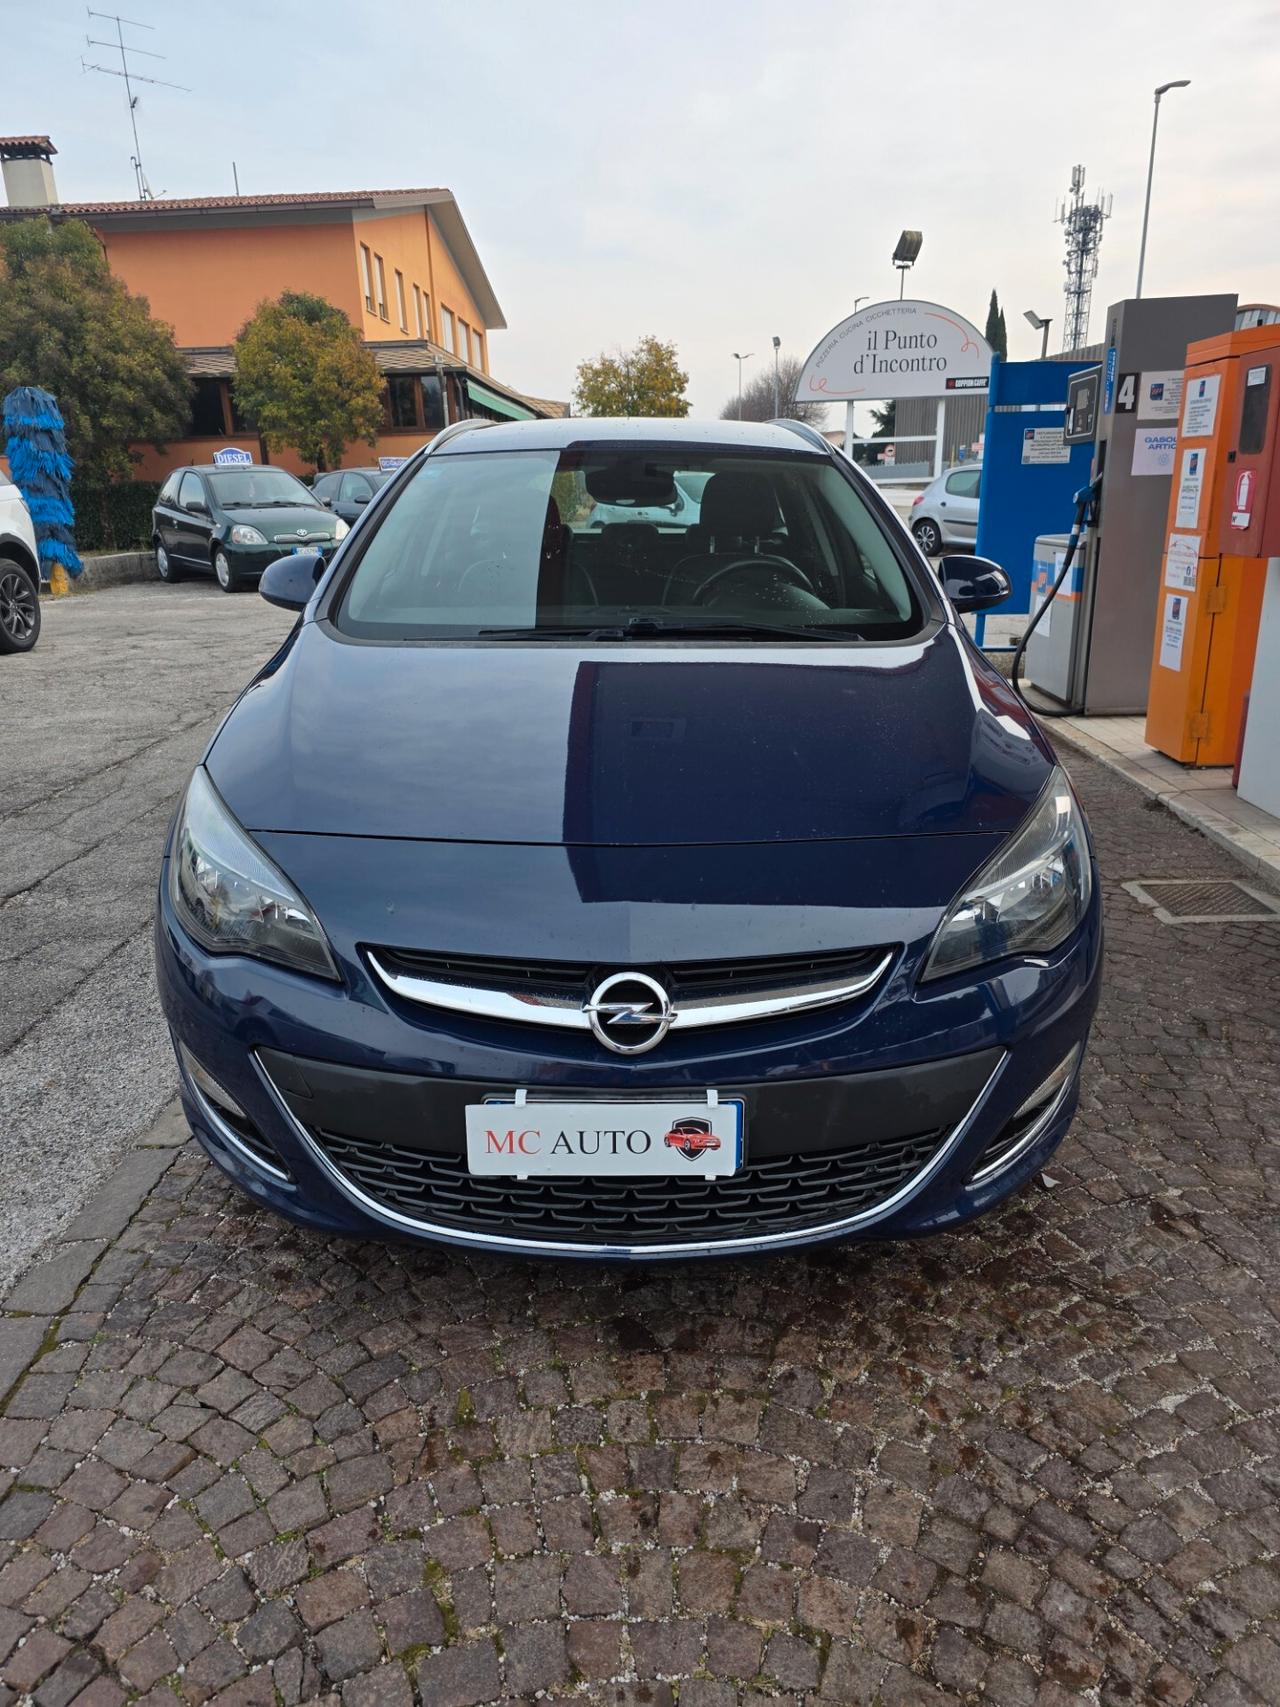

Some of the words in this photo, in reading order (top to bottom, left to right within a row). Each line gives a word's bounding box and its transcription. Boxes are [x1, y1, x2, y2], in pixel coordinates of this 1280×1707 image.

[816, 339, 838, 368] PIZZERIA
[839, 320, 864, 339] CUCINA
[865, 308, 917, 321] CICCHETTERIA
[867, 330, 877, 350] il
[884, 330, 938, 350] Punto
[853, 353, 947, 375] d'Incontro
[1118, 376, 1135, 410] 4
[216, 453, 250, 464] DIESEL
[484, 1129, 541, 1155] MC
[550, 1129, 652, 1155] AUTO
